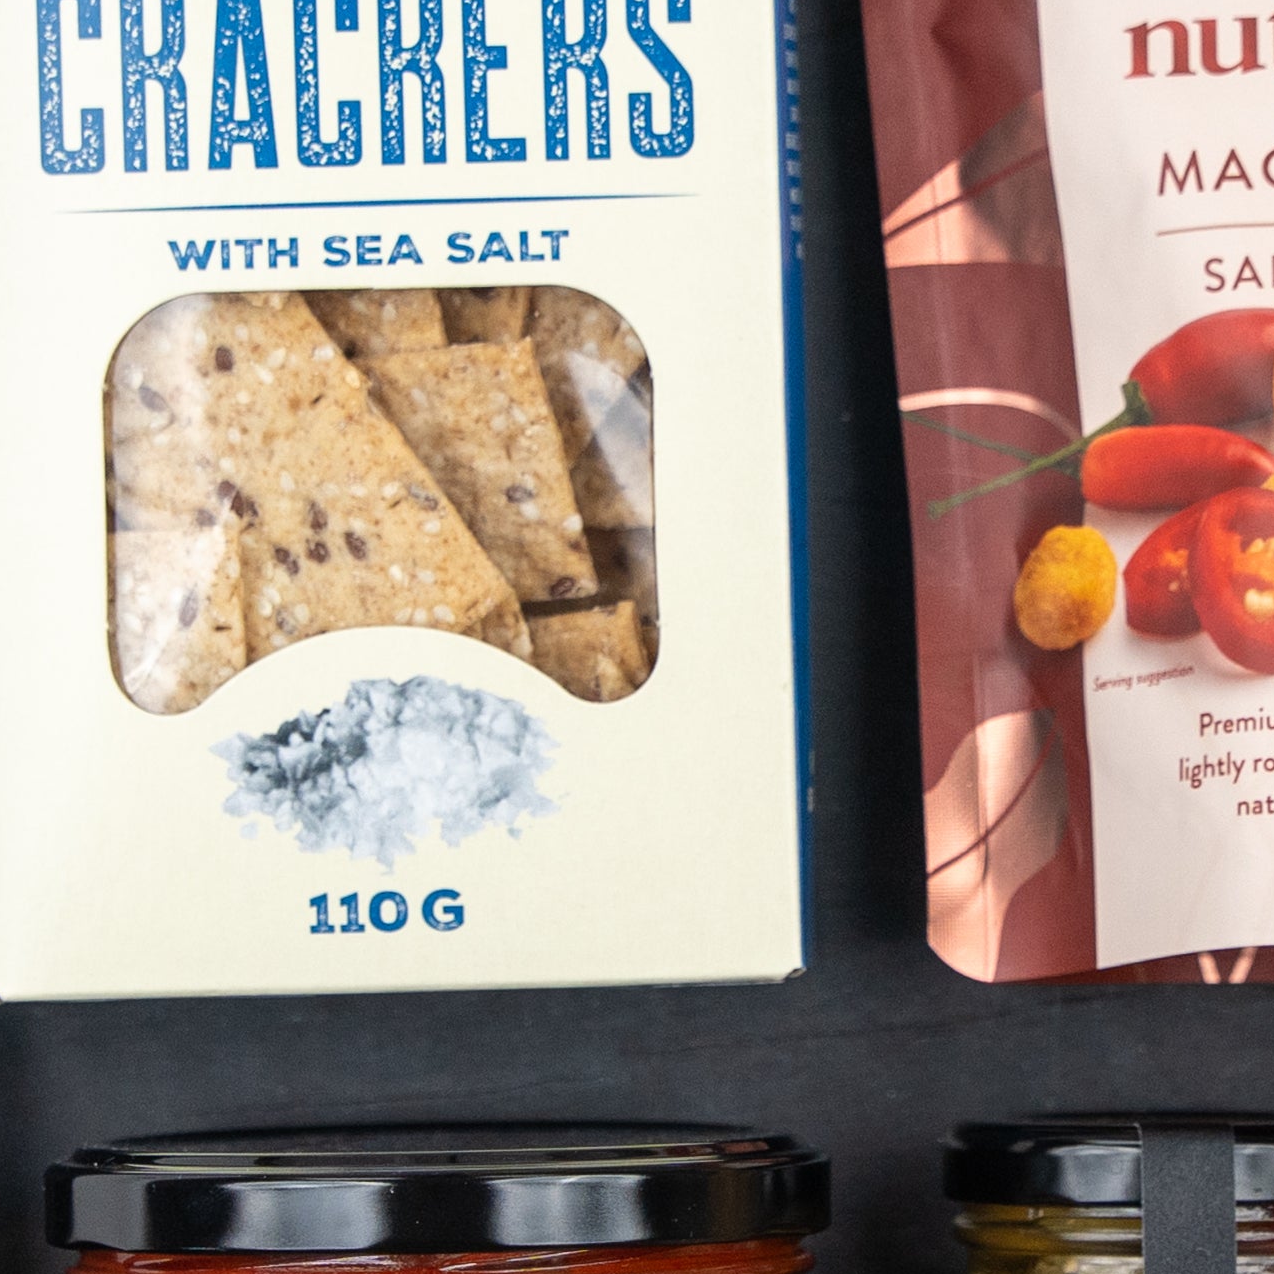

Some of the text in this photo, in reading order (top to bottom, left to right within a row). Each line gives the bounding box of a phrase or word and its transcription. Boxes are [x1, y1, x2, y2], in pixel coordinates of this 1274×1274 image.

[169, 229, 569, 272] WITH SEA SALT
[1178, 752, 1246, 788] lightly
